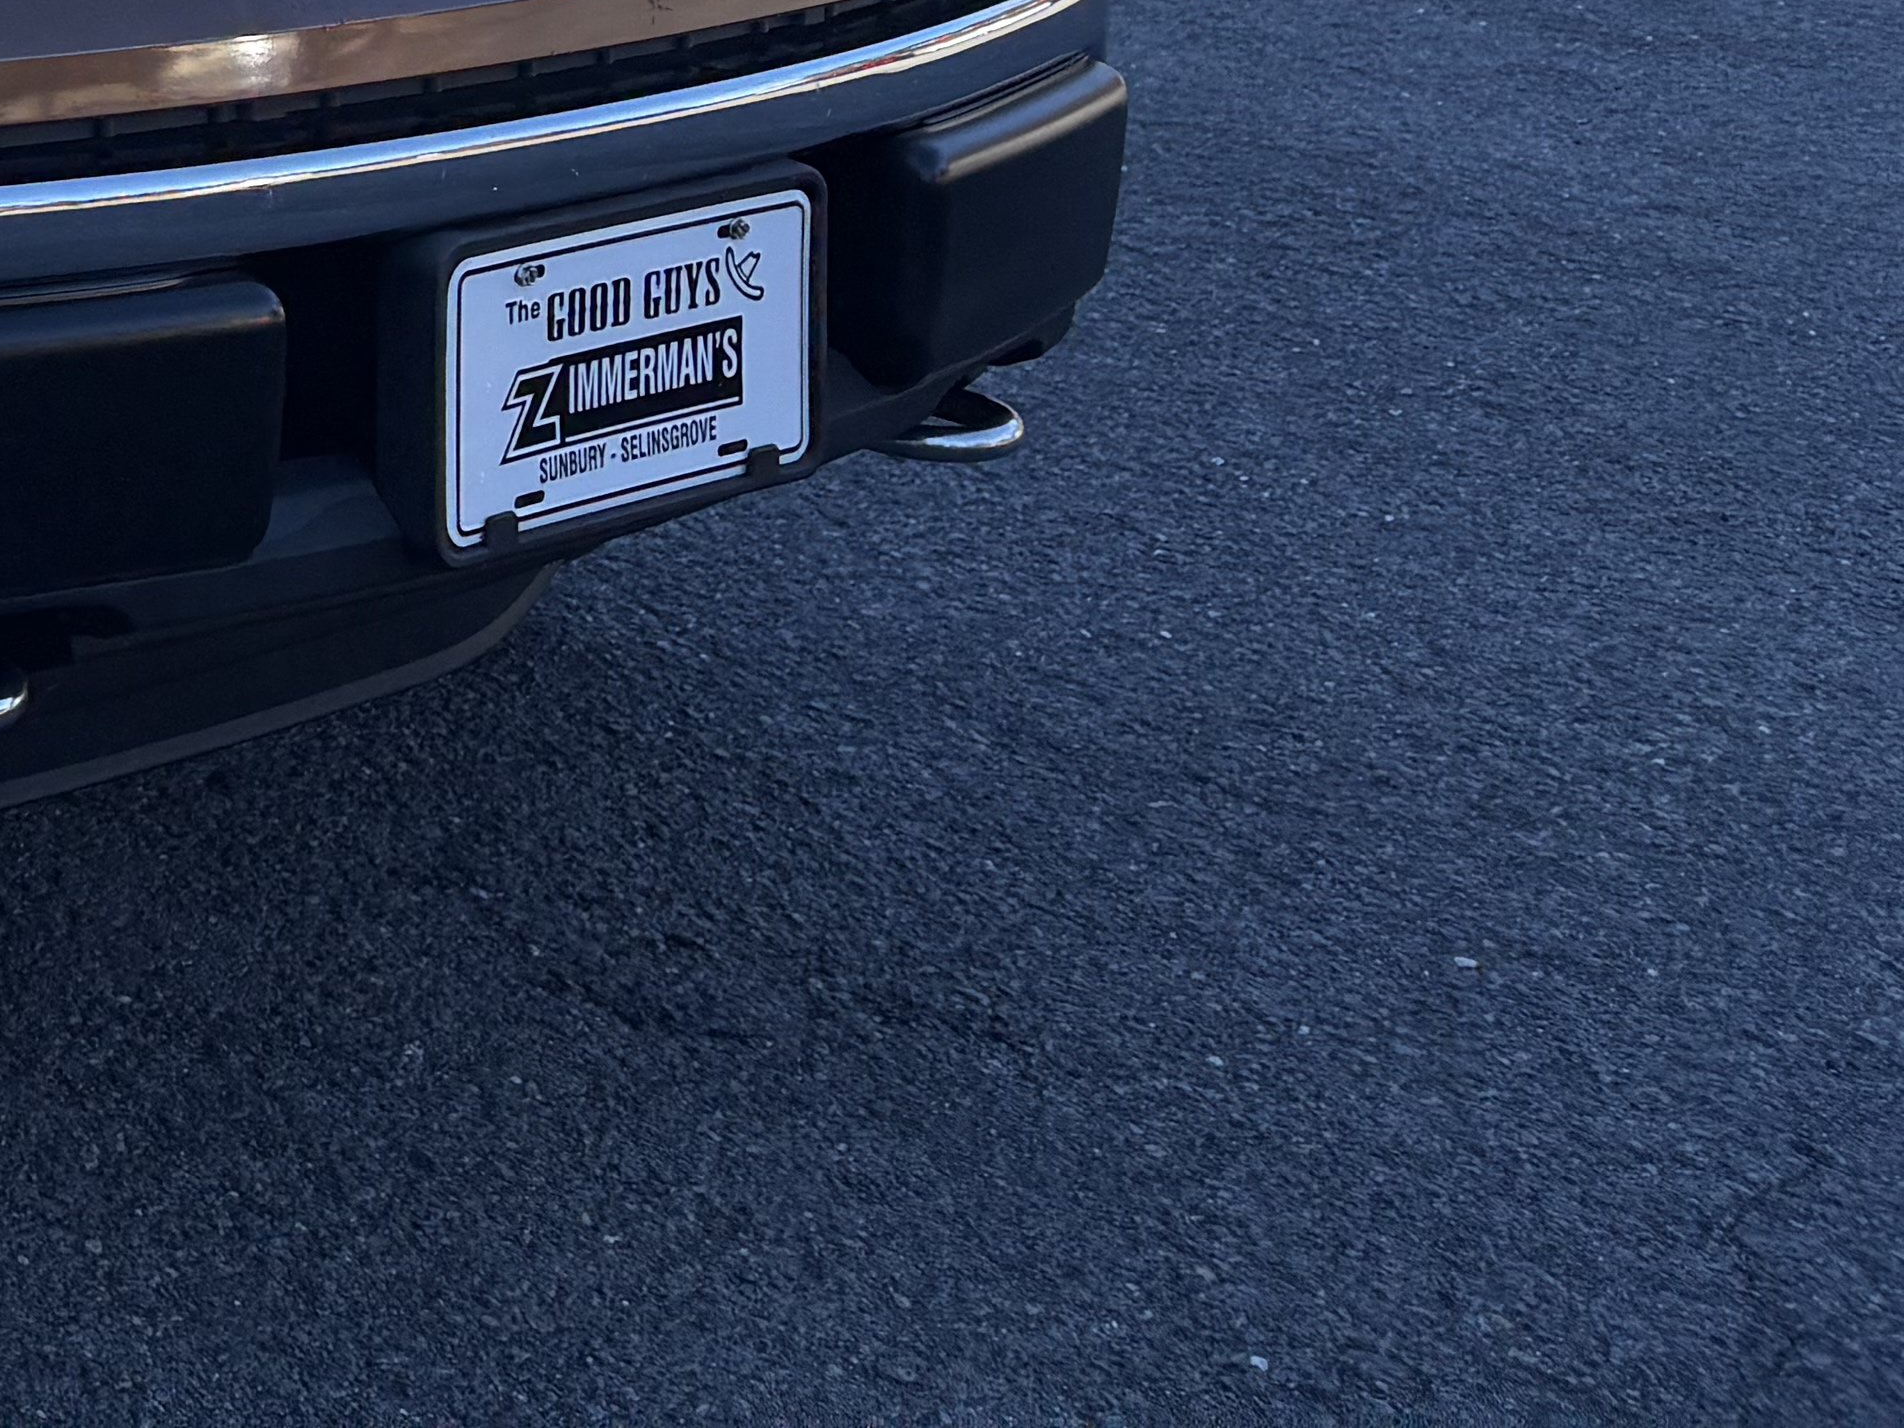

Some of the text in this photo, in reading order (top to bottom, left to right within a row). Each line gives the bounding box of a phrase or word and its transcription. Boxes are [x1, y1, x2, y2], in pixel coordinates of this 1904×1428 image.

[505, 257, 721, 342] The GOOD GUYS
[539, 443, 607, 484] SUNBURY
[620, 415, 718, 463] SELINSGROVE
